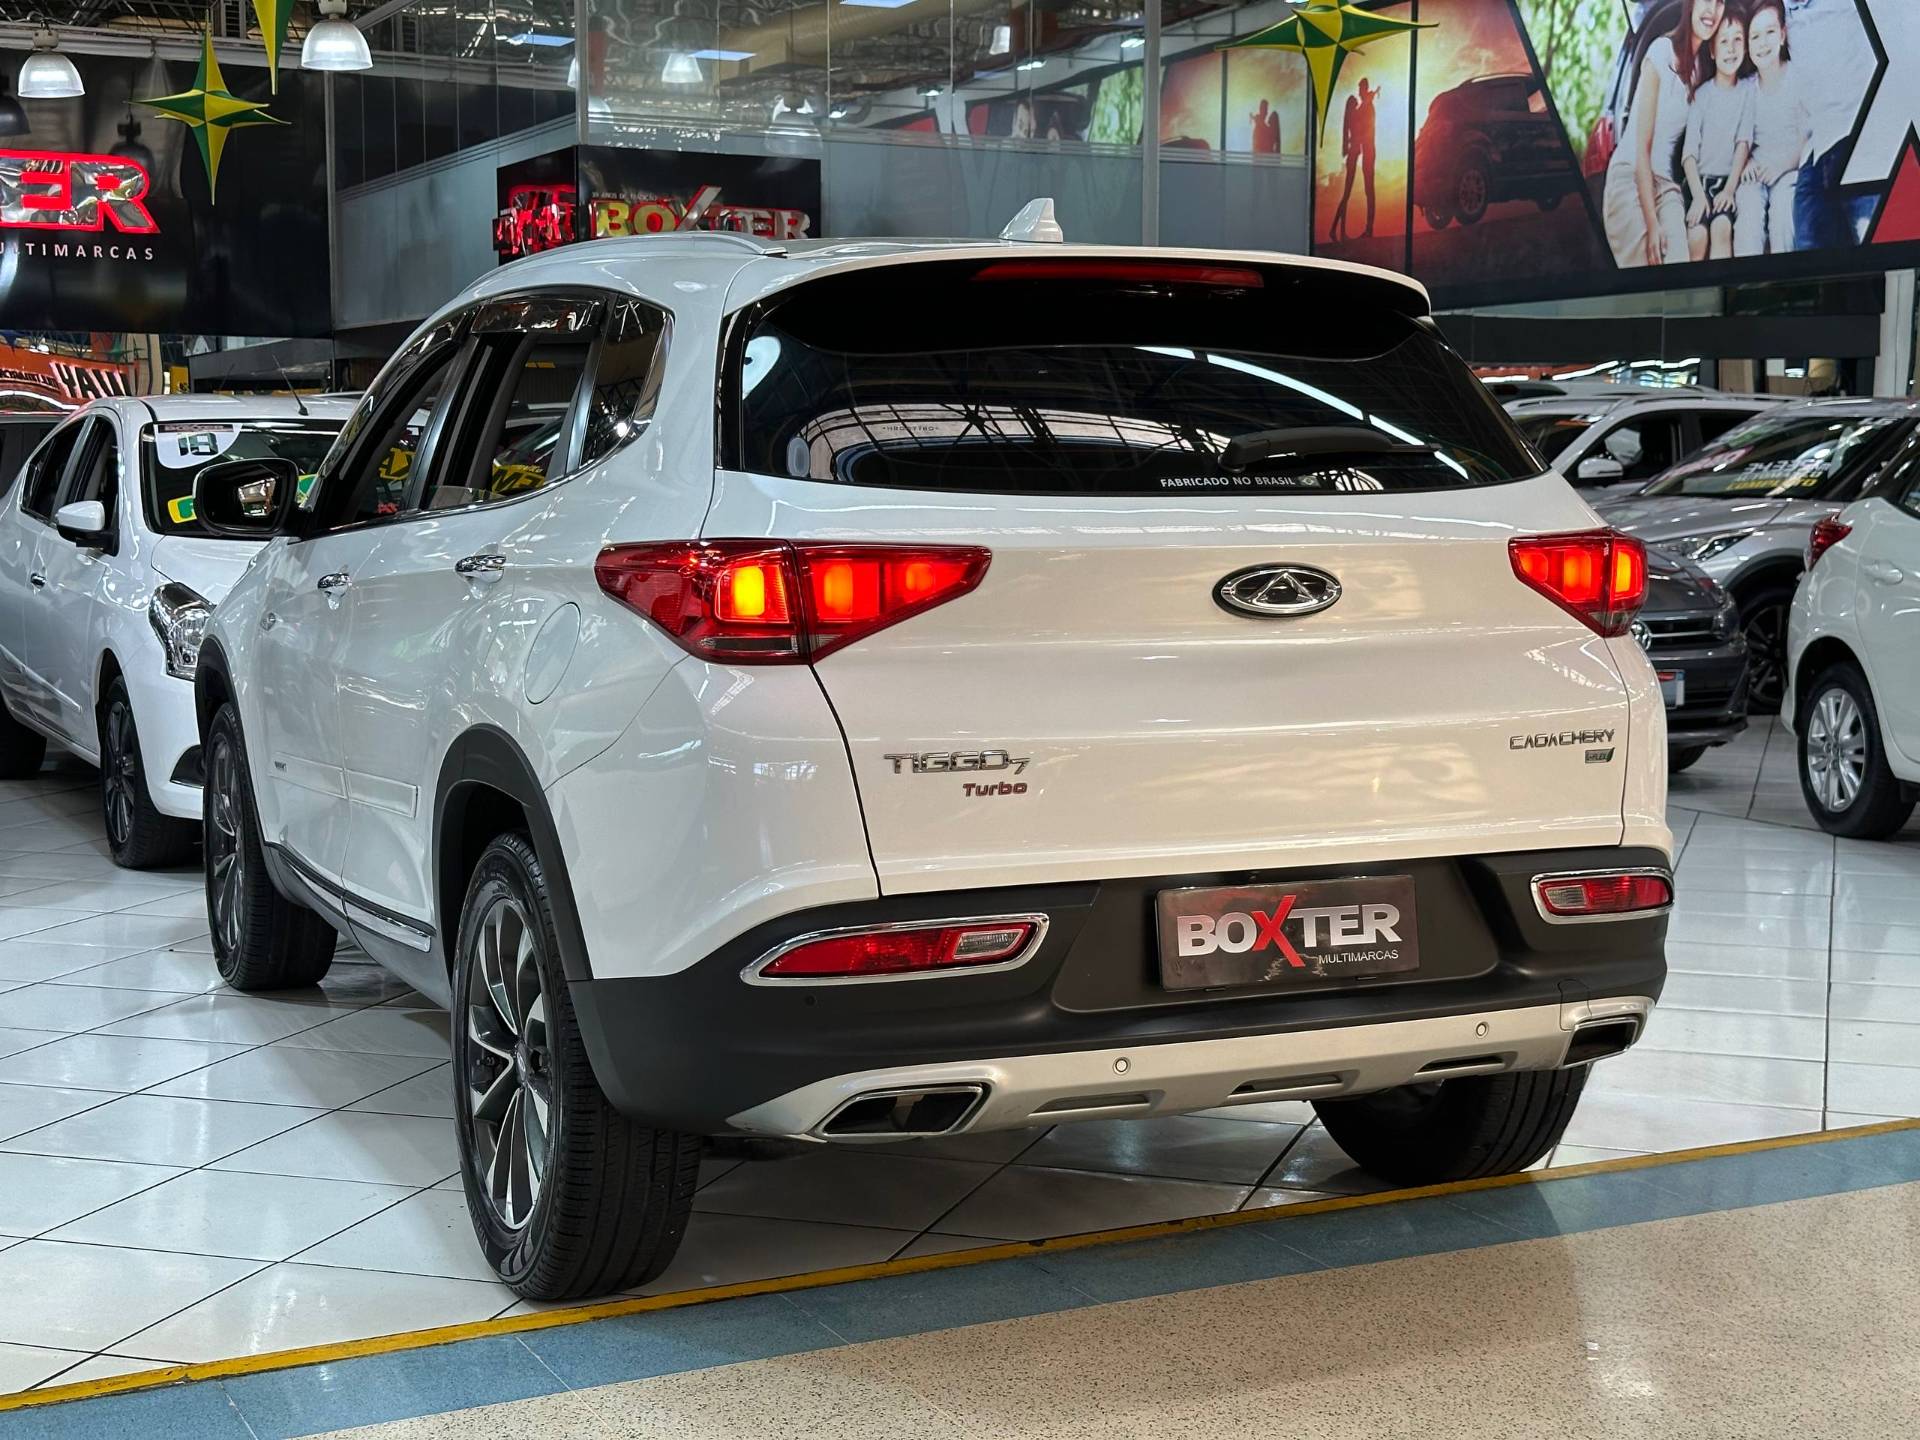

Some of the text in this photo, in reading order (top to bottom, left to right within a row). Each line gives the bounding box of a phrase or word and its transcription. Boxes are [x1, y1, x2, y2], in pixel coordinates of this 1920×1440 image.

[1160, 476, 1296, 488] FABRICADO NO BRASIL
[962, 781, 1028, 797] Turbo
[1177, 894, 1403, 968] BOXTER
[1318, 949, 1399, 965] MULTIMARCAS
